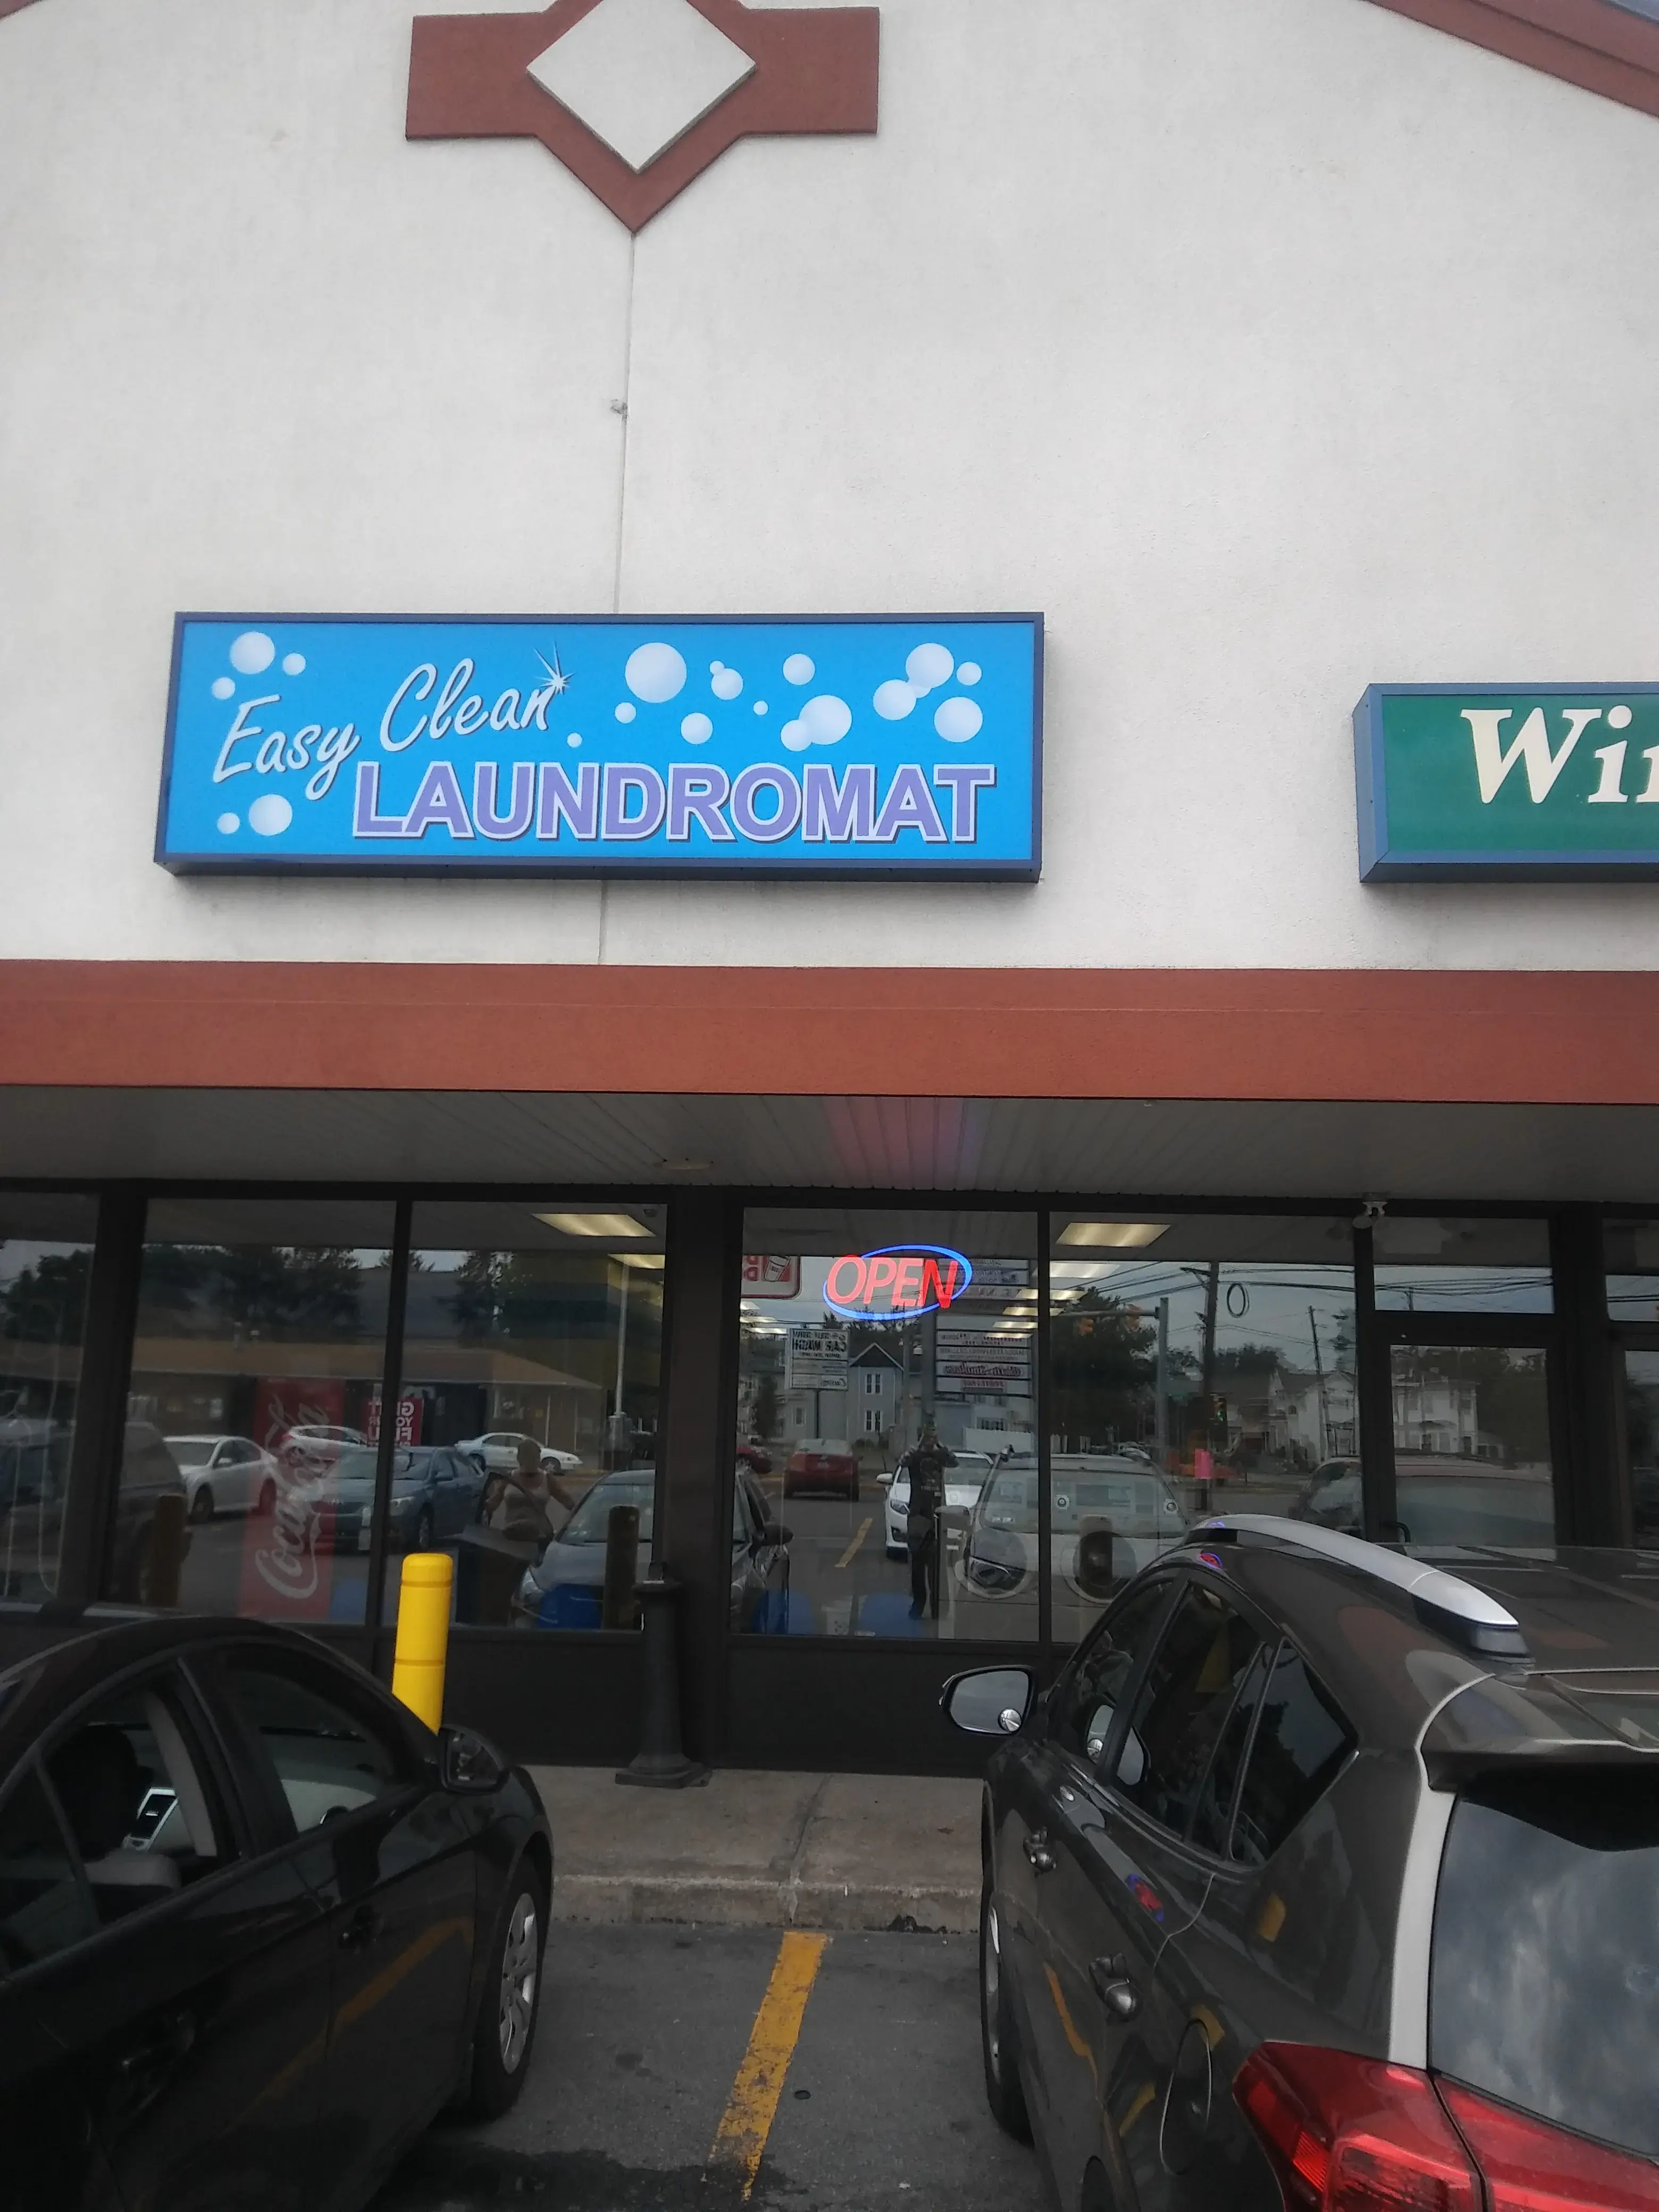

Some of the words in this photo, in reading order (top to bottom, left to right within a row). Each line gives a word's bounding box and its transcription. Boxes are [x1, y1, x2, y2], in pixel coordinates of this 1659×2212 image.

[213, 694, 362, 801] Easy
[379, 658, 555, 752] Clean
[352, 760, 998, 843] LAUNDROMAT
[827, 1255, 958, 1309] OPEN
